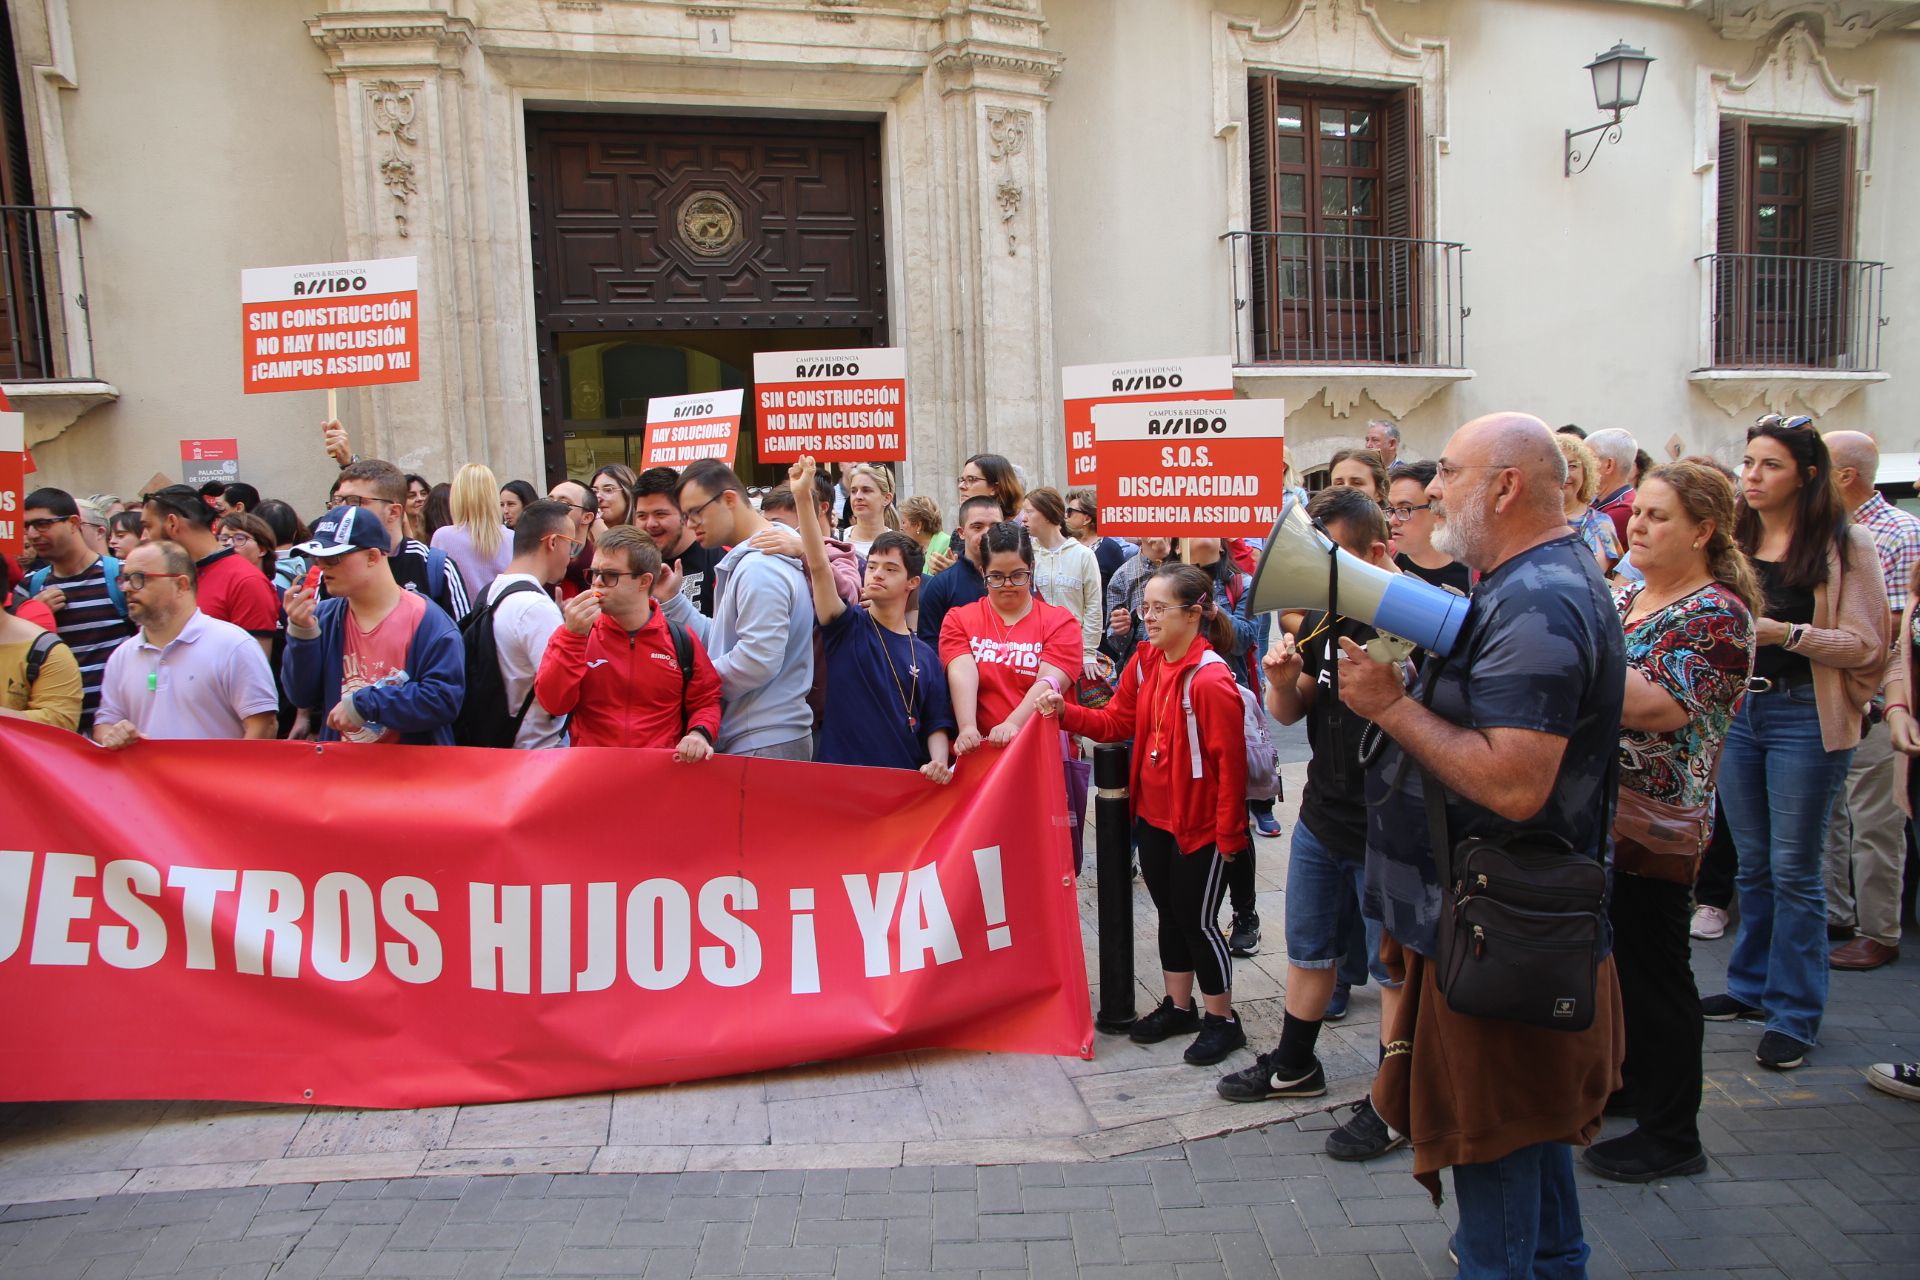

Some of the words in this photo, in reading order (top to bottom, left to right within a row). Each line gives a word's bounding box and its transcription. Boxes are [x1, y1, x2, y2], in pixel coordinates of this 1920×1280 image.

[711, 28, 718, 44] 1
[328, 268, 366, 276] RESIDENCIA
[294, 276, 367, 295] ASSIDO
[249, 311, 278, 331] SIN
[282, 299, 411, 329] CONSTRUCCIÓN
[256, 336, 280, 356] NO
[283, 334, 315, 354] HAY
[317, 325, 405, 351] INCLUSIÓN
[252, 358, 324, 382] ¡CAMPUS
[326, 353, 384, 375] ASSIDO
[387, 351, 411, 369] YA!
[796, 362, 860, 378] ASSIDO
[1112, 368, 1138, 376] CAMPUS
[1144, 365, 1182, 374] RESIDENCIA
[1112, 373, 1183, 392] ASSIDO
[761, 391, 784, 409] SIN
[787, 385, 900, 408] CONSTRUCCIÓN
[674, 403, 714, 418] ASSIDO
[767, 414, 786, 430] NO
[788, 413, 814, 430] HAY
[817, 408, 894, 429] INCLUSIÓN
[1185, 408, 1227, 416] RESIDENCIA
[651, 427, 671, 443] HAY
[671, 422, 732, 442] SOLUCIONES
[1148, 417, 1227, 435] ASSIDO
[764, 435, 823, 454] ¡CAMPUS
[825, 434, 875, 451] ASSIDO
[877, 433, 899, 449] YA!
[1072, 431, 1092, 449] DE
[650, 447, 676, 463] FALTA
[677, 443, 728, 461] VOLUNTAD
[1161, 445, 1213, 468] S.O.S.
[1118, 475, 1259, 497] DISCAPACIDAD
[1101, 506, 1189, 524] ¡RESIDENCIA
[1193, 506, 1250, 523] ASSIDO
[1253, 506, 1278, 523] YA!
[469, 875, 762, 994] HIJOS
[841, 861, 963, 978] YA
[972, 845, 1012, 952] !
